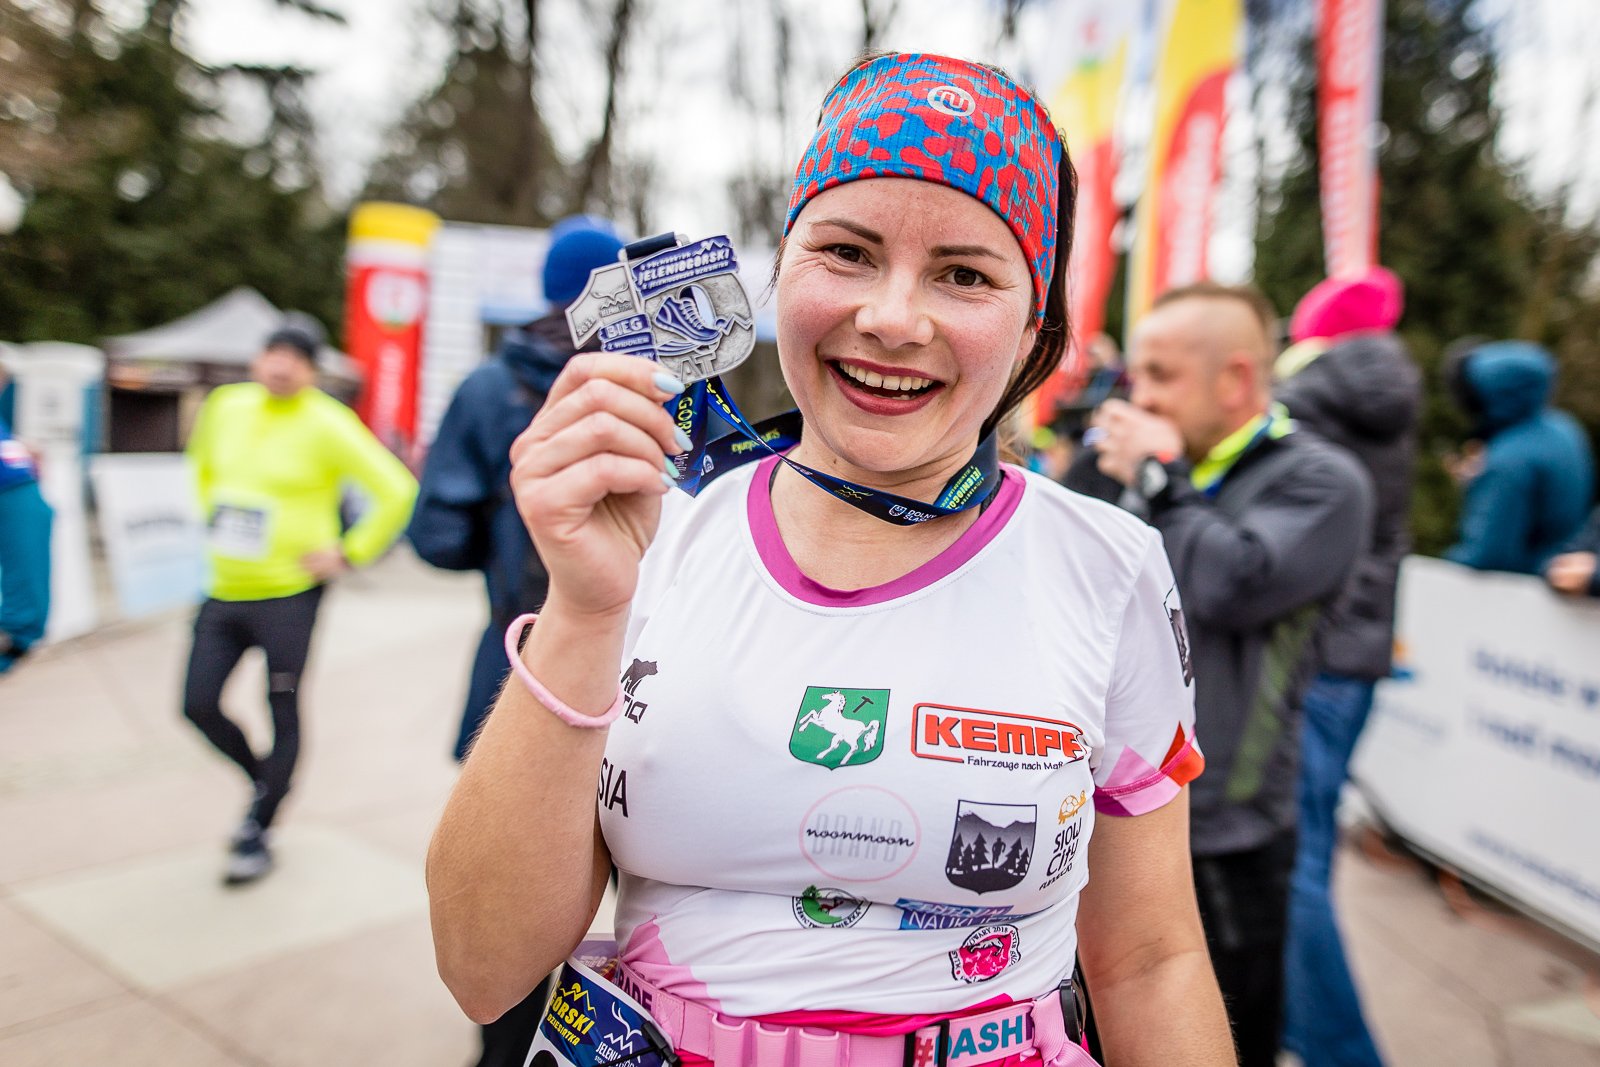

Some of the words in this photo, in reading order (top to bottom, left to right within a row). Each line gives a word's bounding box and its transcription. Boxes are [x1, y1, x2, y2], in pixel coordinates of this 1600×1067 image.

[606, 317, 643, 339] BIEG
[924, 713, 1083, 760] KEMPF
[967, 755, 1019, 772] Fahrzeuge
[1021, 761, 1042, 771] nach
[806, 828, 915, 847] noonmoon
